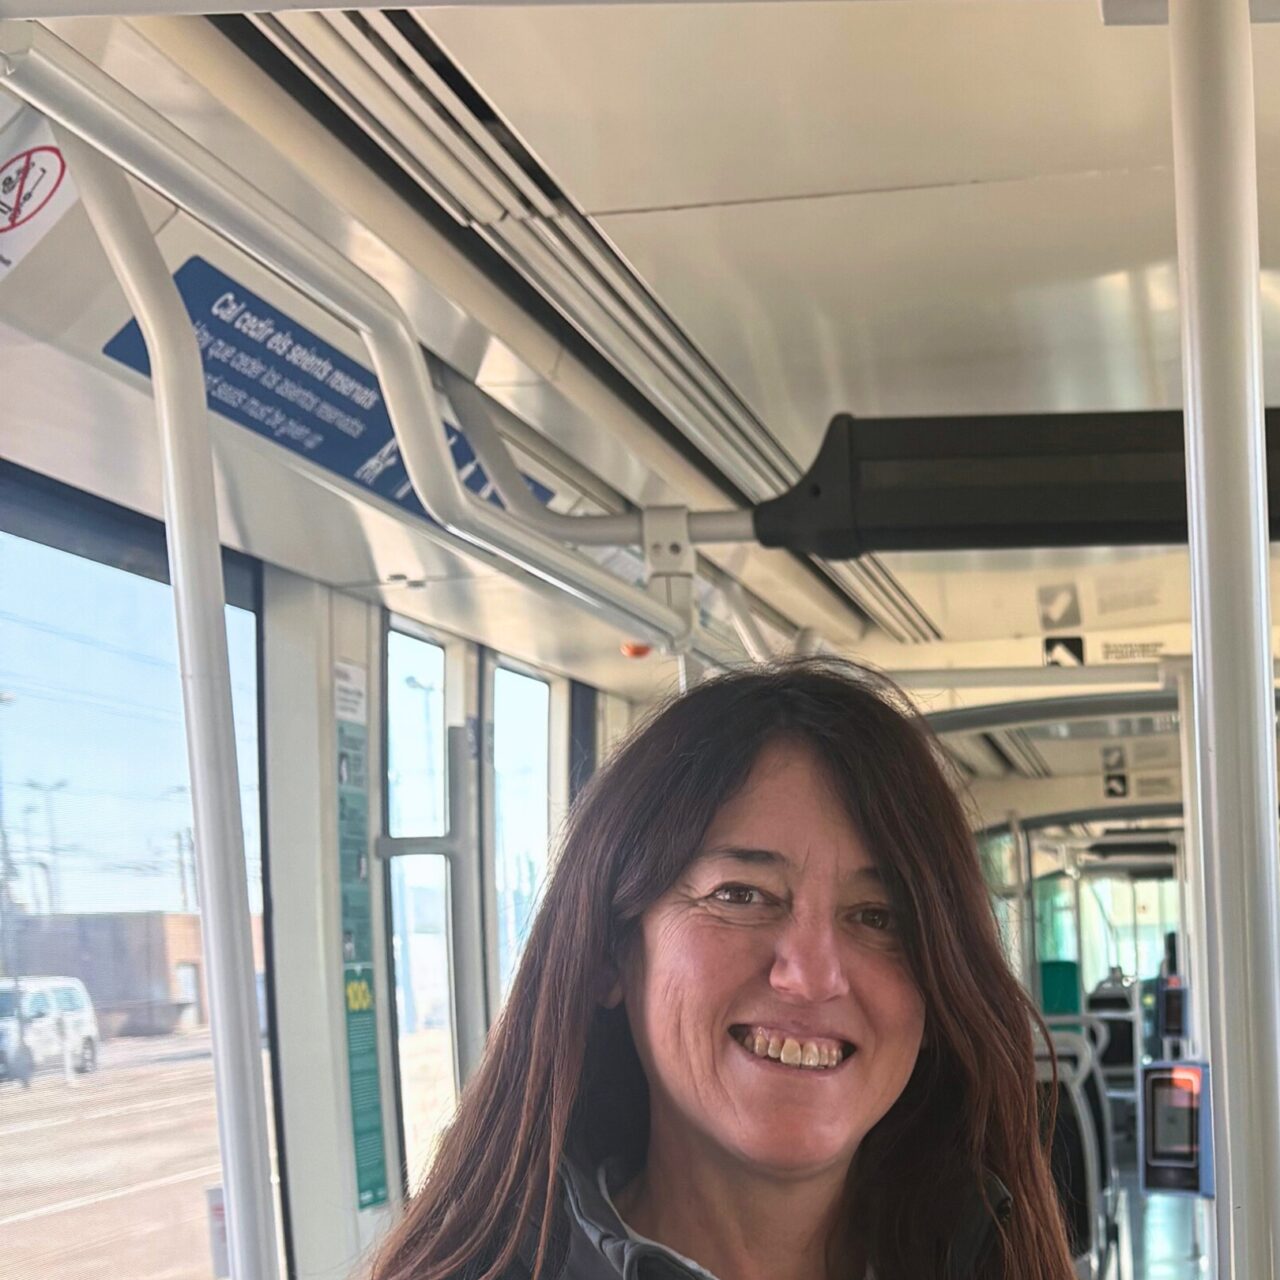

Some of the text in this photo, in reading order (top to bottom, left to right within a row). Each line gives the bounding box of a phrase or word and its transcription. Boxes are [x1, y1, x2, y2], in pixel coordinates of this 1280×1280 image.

[211, 292, 246, 323] Cal
[234, 311, 275, 343] cedir
[266, 331, 294, 356] els
[208, 338, 236, 363] que
